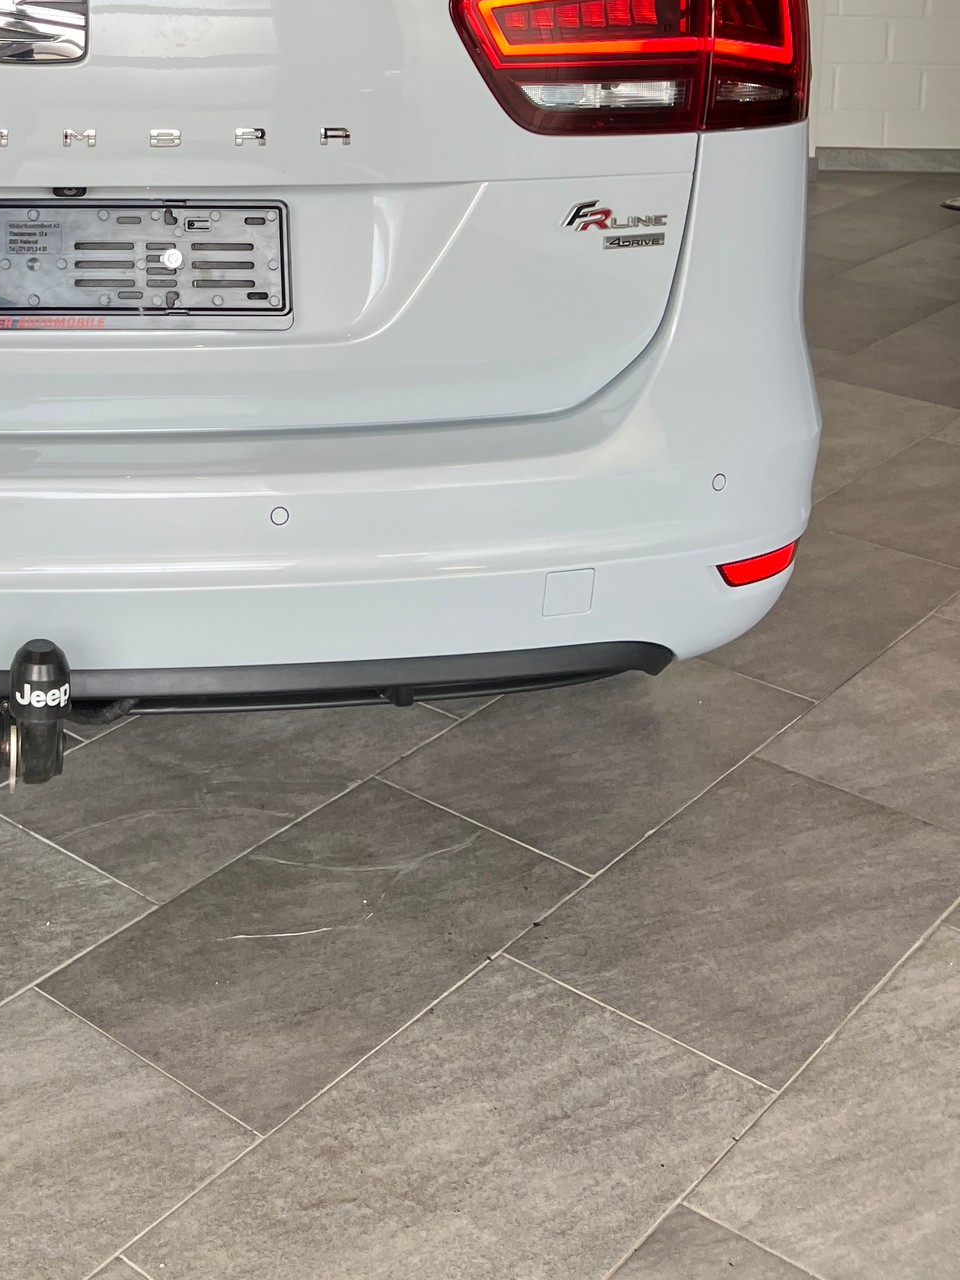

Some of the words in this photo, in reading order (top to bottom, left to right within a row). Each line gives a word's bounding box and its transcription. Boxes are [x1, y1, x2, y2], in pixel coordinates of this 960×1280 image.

[611, 214, 668, 229] LINE
[17, 317, 106, 329] AUTOMOBILE
[15, 682, 70, 708] Jeep
